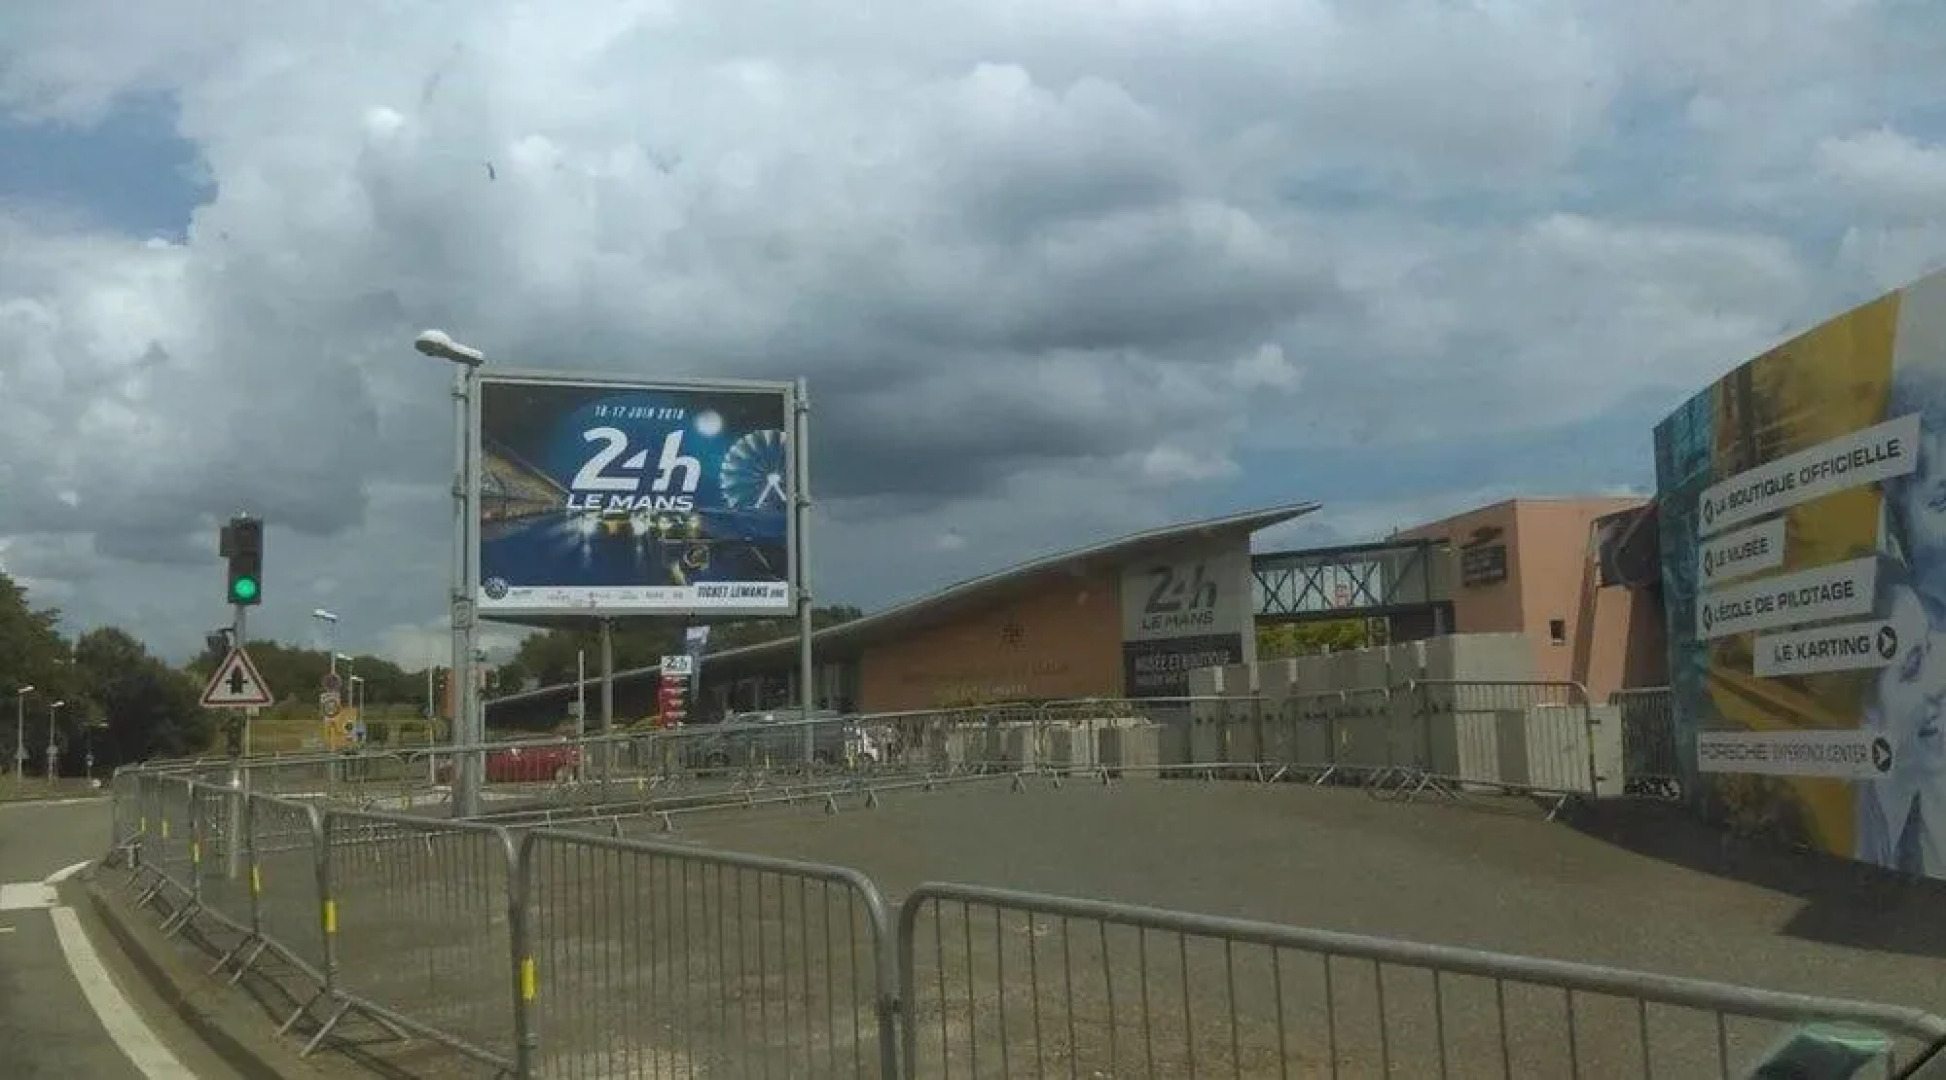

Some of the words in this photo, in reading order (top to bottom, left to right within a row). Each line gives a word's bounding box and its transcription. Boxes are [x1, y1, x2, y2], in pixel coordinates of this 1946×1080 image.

[572, 427, 700, 491] 24h
[1729, 472, 1795, 509] BOUTIQUE
[1800, 439, 1900, 484] OFFICIELLE
[567, 494, 603, 509] LE
[604, 494, 694, 512] MANS
[1714, 549, 1726, 567] LE
[1145, 564, 1217, 614] 24h
[1755, 595, 1774, 614] DE
[1778, 580, 1855, 609] PILOTAGE
[1142, 614, 1162, 631] LE
[1165, 610, 1215, 629] MANS
[1775, 645, 1794, 662] LE
[1797, 635, 1871, 660] KARTING
